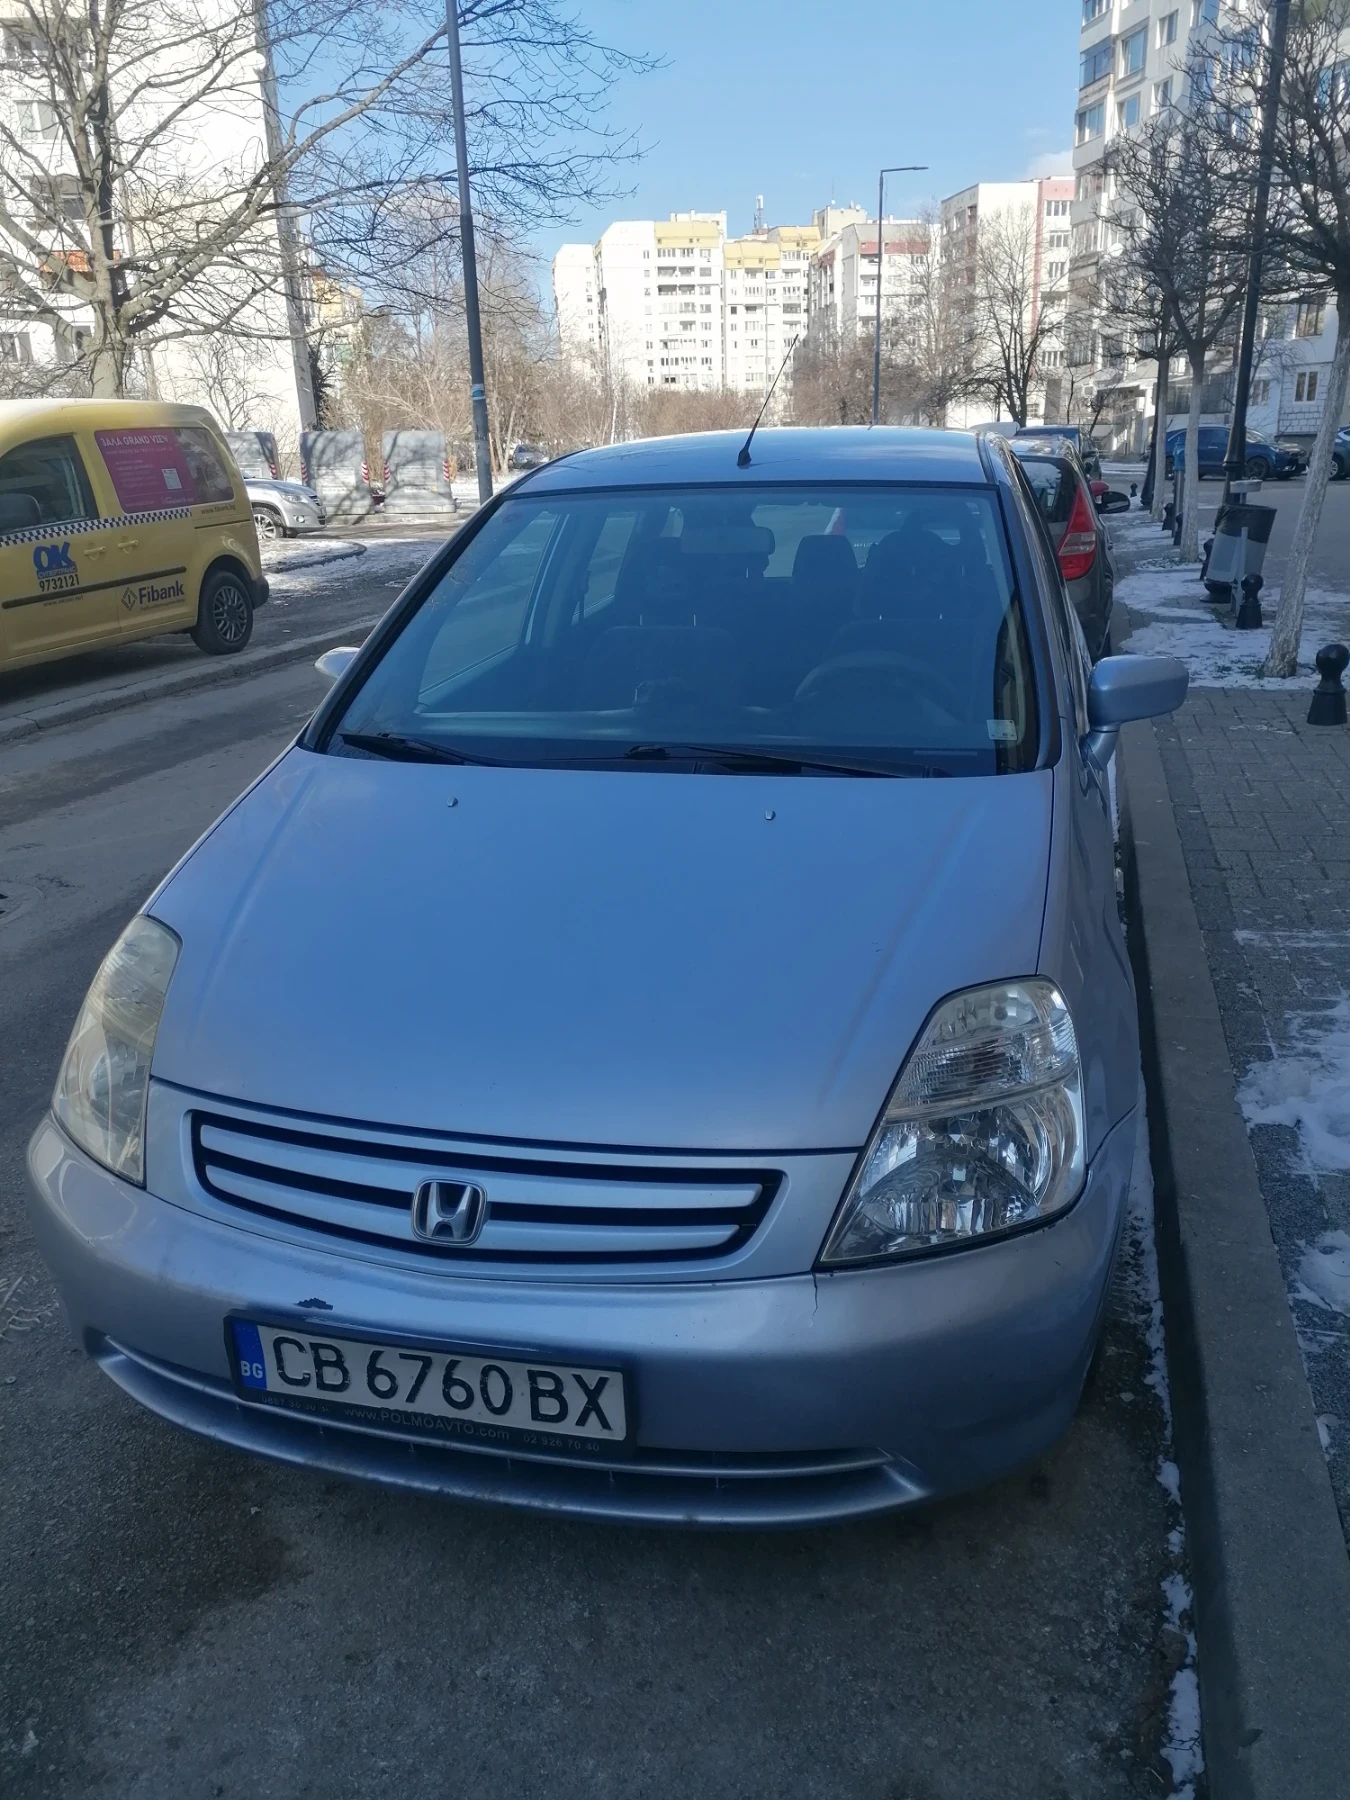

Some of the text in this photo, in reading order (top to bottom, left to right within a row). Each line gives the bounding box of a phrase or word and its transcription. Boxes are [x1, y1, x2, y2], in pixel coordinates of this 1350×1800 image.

[123, 435, 150, 445] GRAND
[150, 434, 169, 444] VIEW
[33, 541, 77, 571] OK
[39, 574, 80, 592] 9732121
[138, 580, 185, 605] Fibank
[240, 1360, 264, 1379] BG
[272, 1336, 613, 1431] CB 6760 BX
[344, 1407, 510, 1441] www.POLMOAVTO.com
